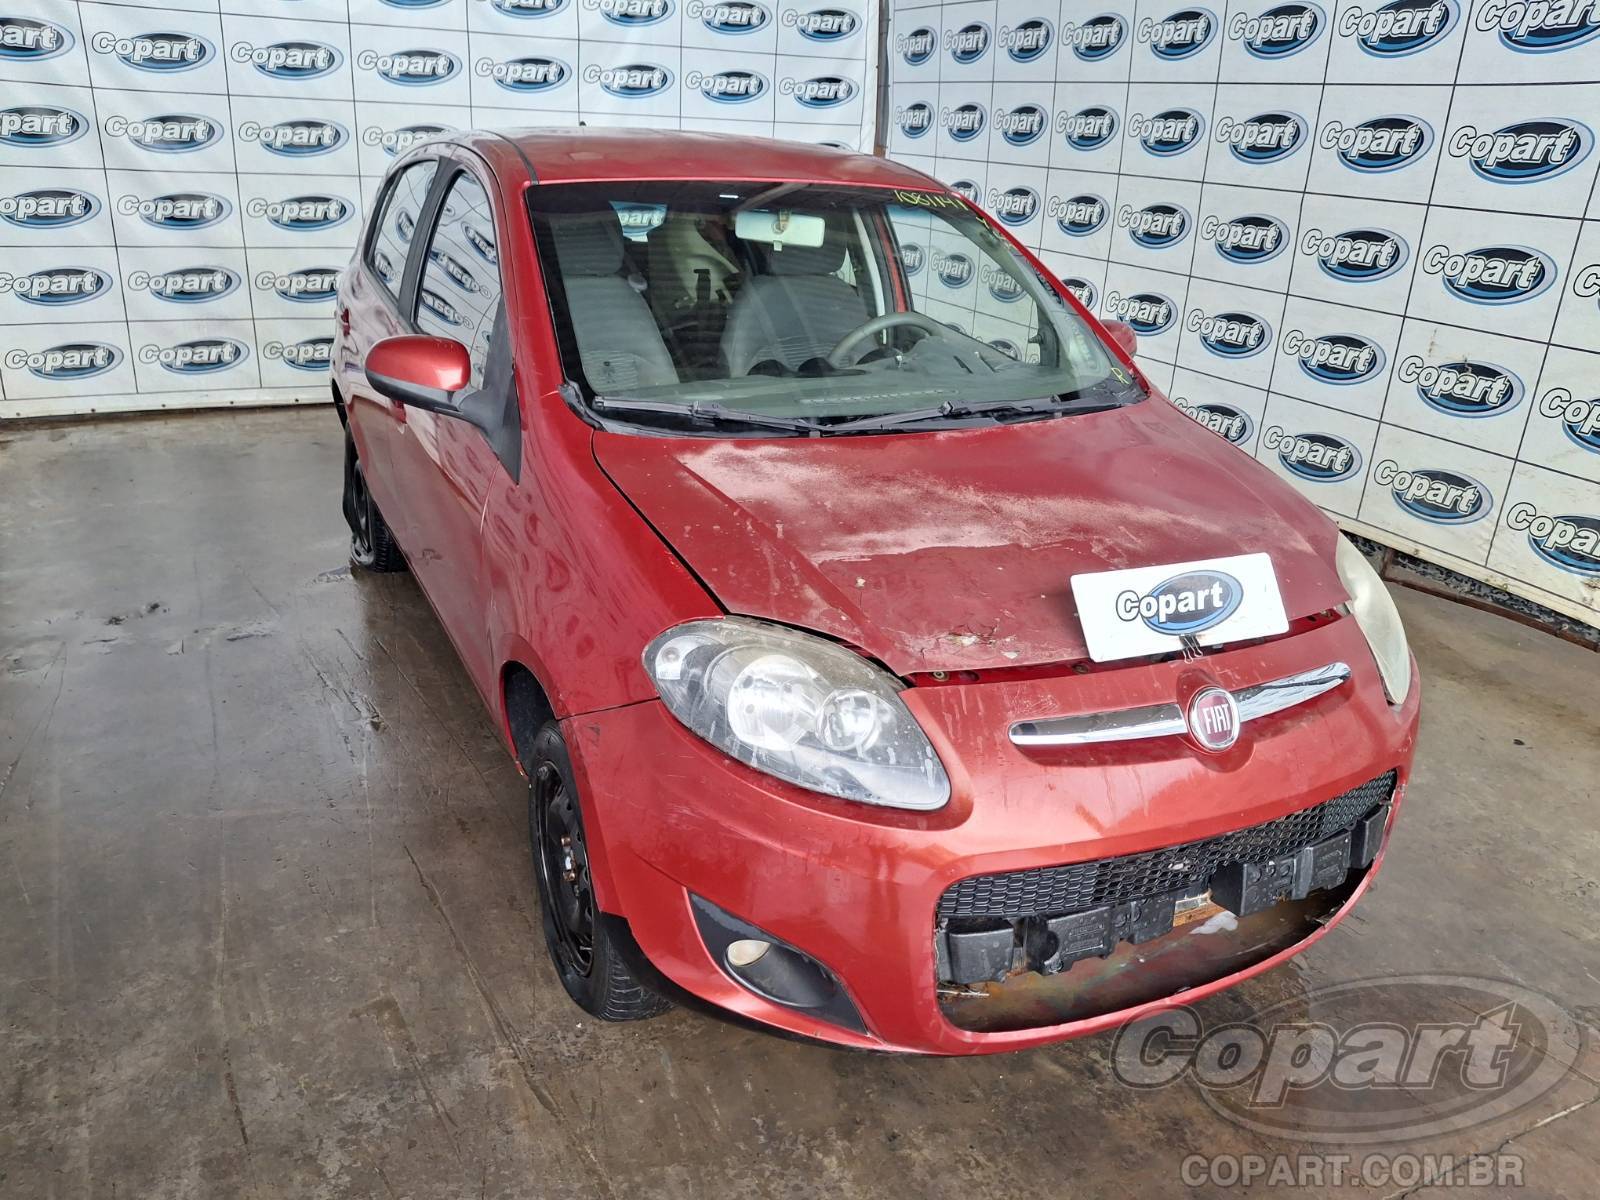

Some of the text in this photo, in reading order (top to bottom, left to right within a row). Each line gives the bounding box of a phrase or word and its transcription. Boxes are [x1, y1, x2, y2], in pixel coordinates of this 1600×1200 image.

[687, 1, 763, 25] Copart
[782, 9, 850, 32] Copart
[1228, 6, 1316, 47] Copart
[1339, 1, 1451, 44] Copart
[0, 25, 57, 50] art
[896, 27, 934, 57] Copart
[944, 25, 987, 56] Copart
[999, 22, 1047, 54] Copart
[1062, 16, 1123, 50] Copart
[1138, 12, 1211, 48] Copart
[92, 31, 201, 62] Copart
[231, 42, 329, 69] Copart
[357, 49, 449, 78] Copart
[475, 58, 560, 85] Copart
[583, 64, 663, 90] Copart
[686, 71, 758, 95] Copart
[779, 77, 847, 99] Copart
[0, 113, 72, 136] part
[105, 115, 208, 142] Copart
[895, 106, 930, 129] Copart
[941, 106, 982, 133] Copart
[994, 109, 1043, 136] Copart
[1056, 111, 1114, 139] Copart
[1128, 113, 1197, 145] Copart
[1215, 116, 1298, 148] Copart
[239, 121, 335, 148] Copart
[1320, 120, 1423, 160] Copart
[1448, 125, 1577, 169] Copart
[0, 194, 86, 219] opart
[118, 194, 218, 222] Copart
[247, 198, 341, 222] Copart
[987, 187, 1036, 216] Copart
[1049, 195, 1106, 225] Copart
[1117, 203, 1184, 237] Copart
[1201, 216, 1281, 250] Copart
[1301, 229, 1397, 268] Copart
[931, 253, 969, 280] Copart
[1422, 245, 1541, 291] Copart
[128, 271, 227, 294] Copart
[1106, 291, 1169, 326] Copart
[1187, 309, 1264, 347] Copart
[5, 346, 108, 374] Copart
[139, 340, 236, 369] Copart
[263, 341, 331, 365] Copa
[1282, 330, 1376, 375] Copart
[1398, 355, 1511, 406] Copart
[1539, 388, 1600, 434] Cop
[1263, 426, 1351, 472] Copart
[1374, 459, 1480, 514] Copart
[1507, 502, 1600, 558] Copa
[1116, 581, 1223, 624] Copart
[1202, 703, 1230, 734] FIAT
